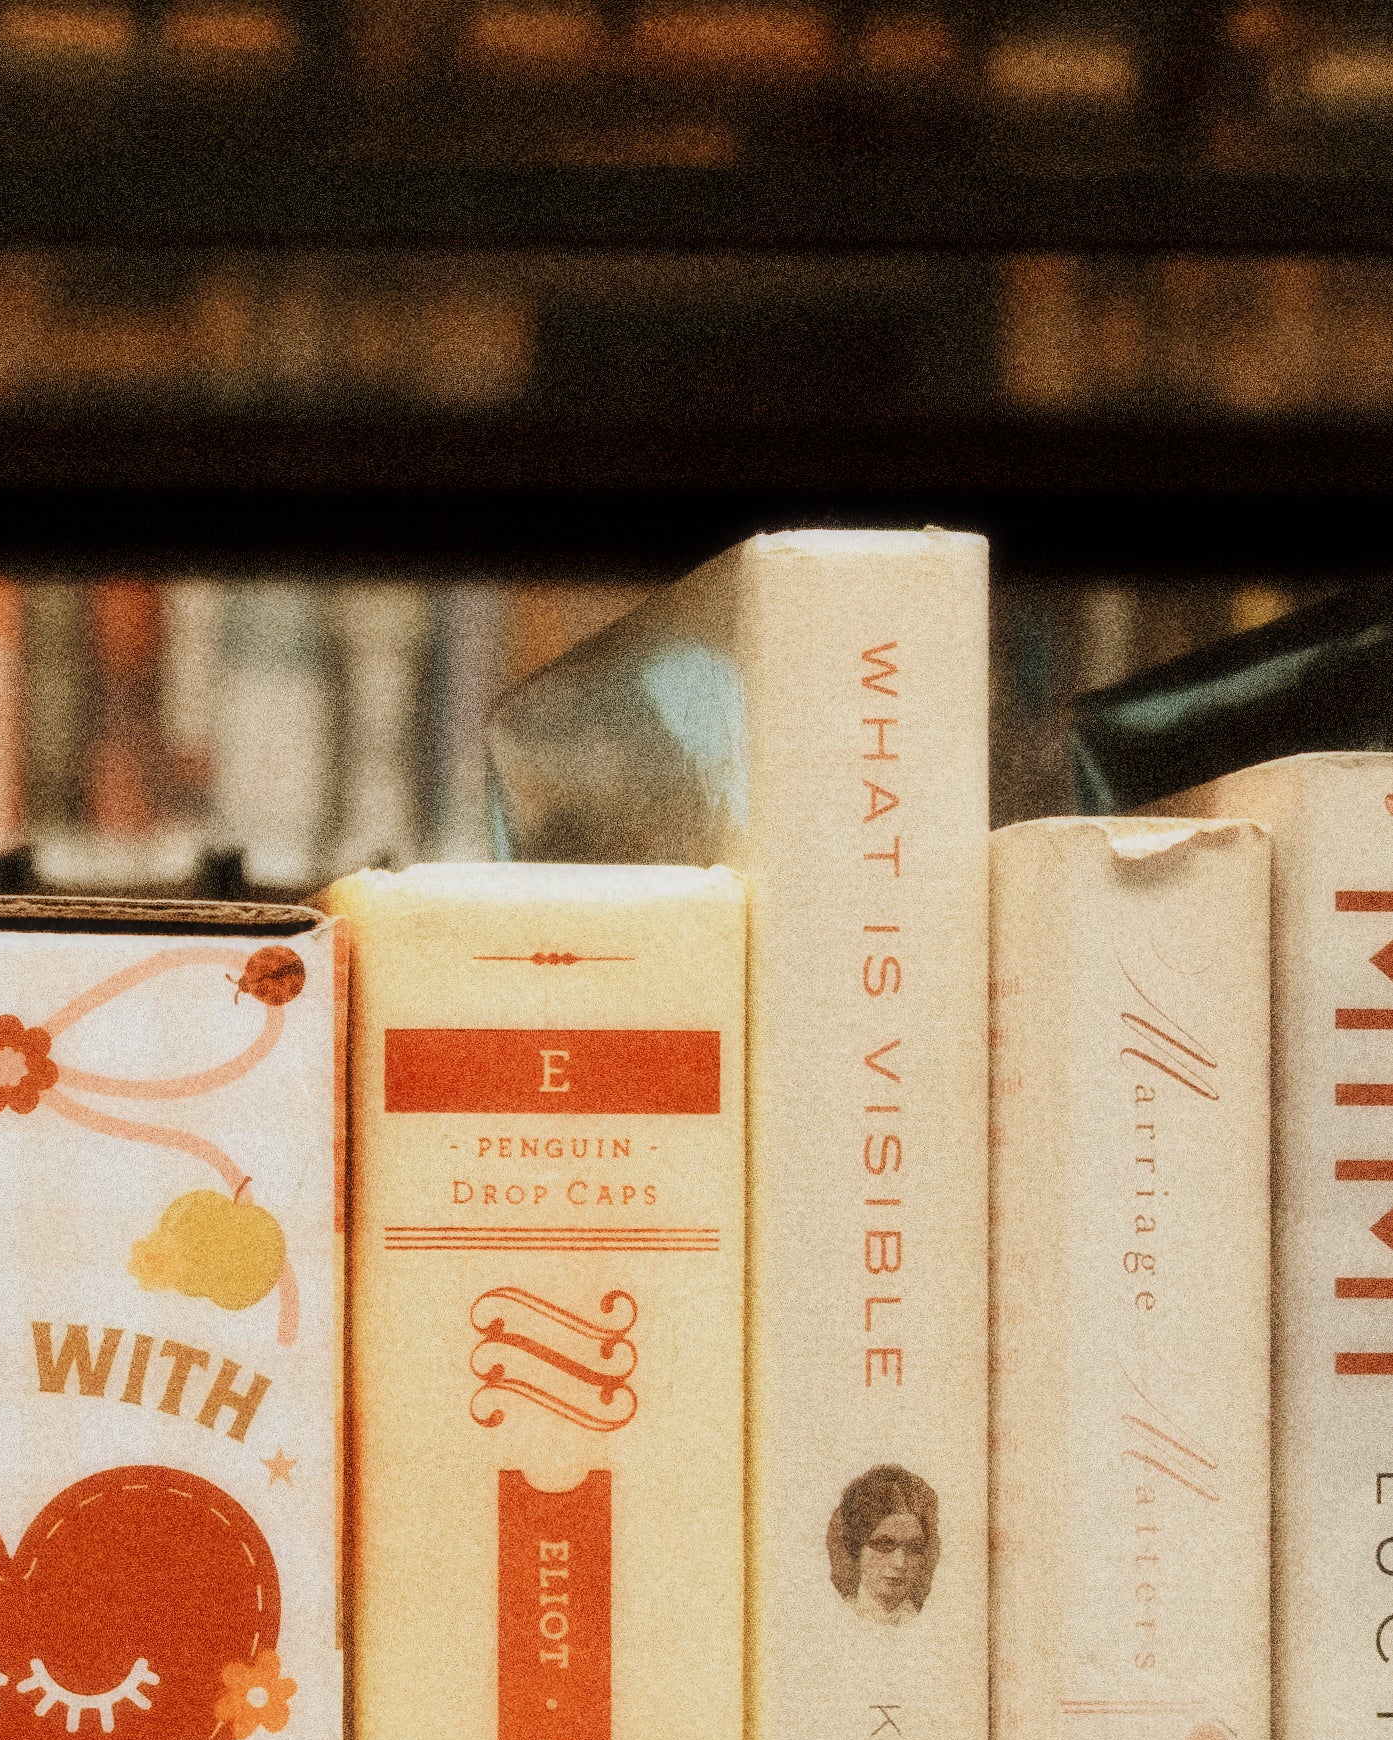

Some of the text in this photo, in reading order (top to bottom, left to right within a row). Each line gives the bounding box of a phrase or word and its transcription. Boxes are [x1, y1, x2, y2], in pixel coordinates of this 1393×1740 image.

[537, 1049, 571, 1094] E
[859, 639, 904, 1388] WHAT IS VISIBLE
[30, 1321, 274, 1445] WITH
[537, 1538, 570, 1669] ELIOT
